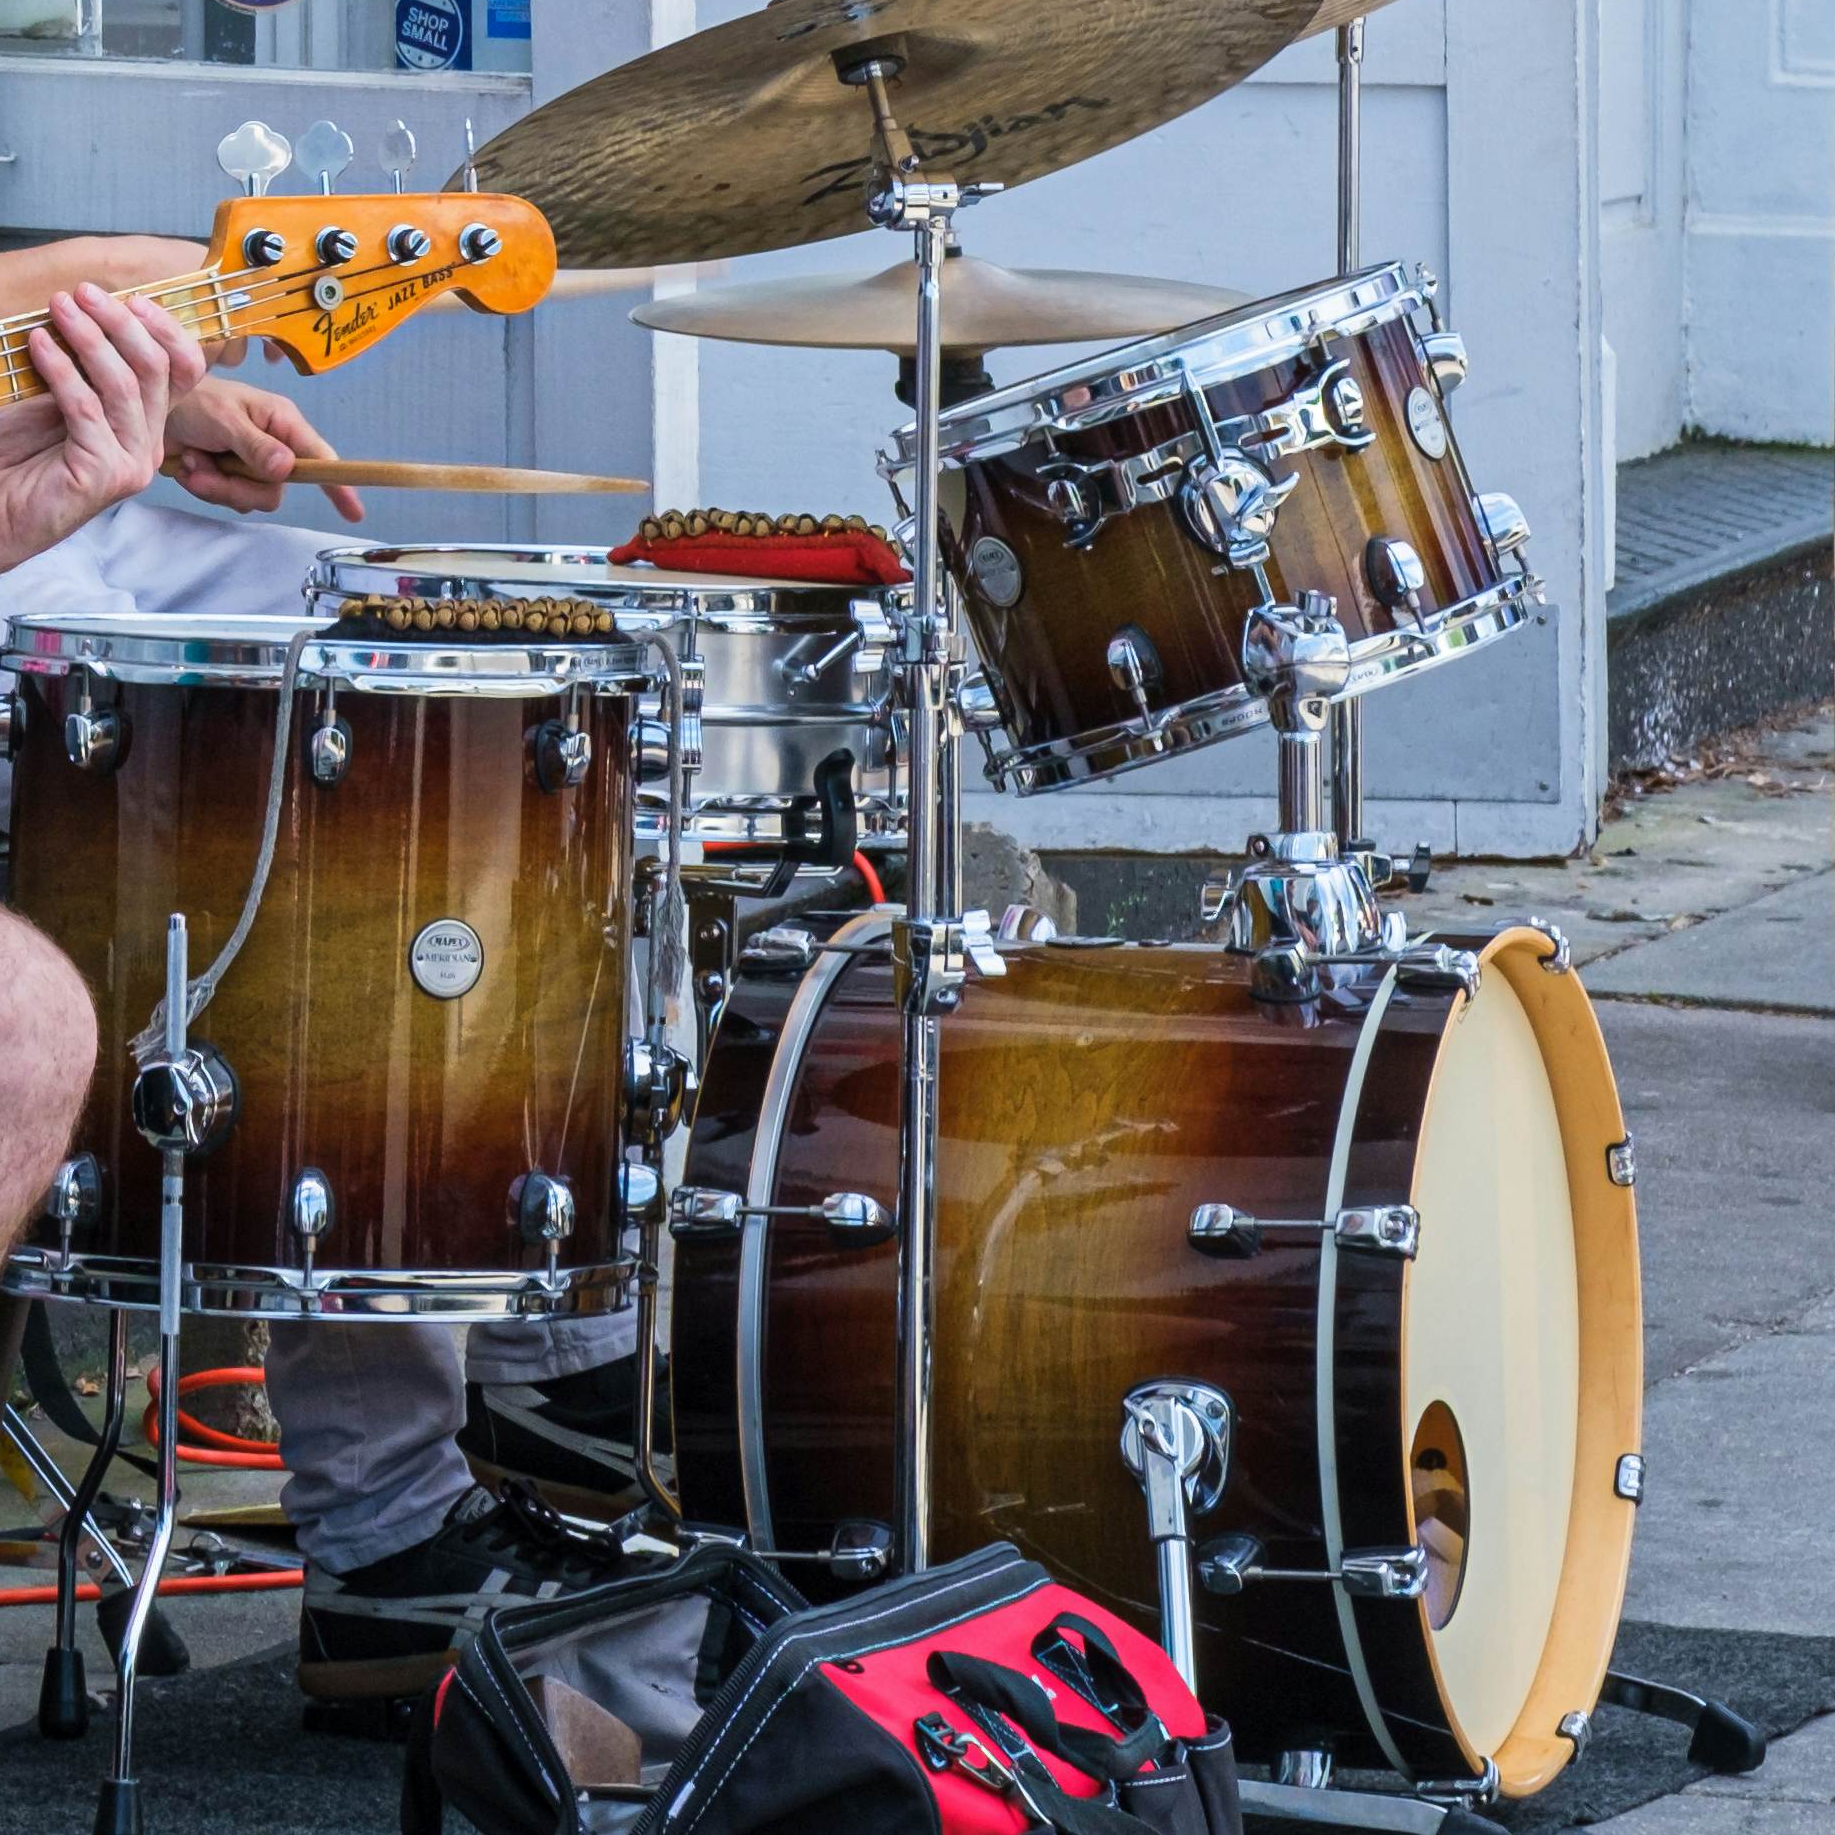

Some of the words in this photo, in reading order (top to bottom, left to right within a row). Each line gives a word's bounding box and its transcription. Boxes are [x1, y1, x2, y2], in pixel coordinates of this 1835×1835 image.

[408, 6, 449, 33] SHOP
[401, 20, 448, 51] SMALL
[313, 302, 378, 357] Fender
[388, 282, 416, 310] JAZZ
[422, 268, 453, 289] BASS
